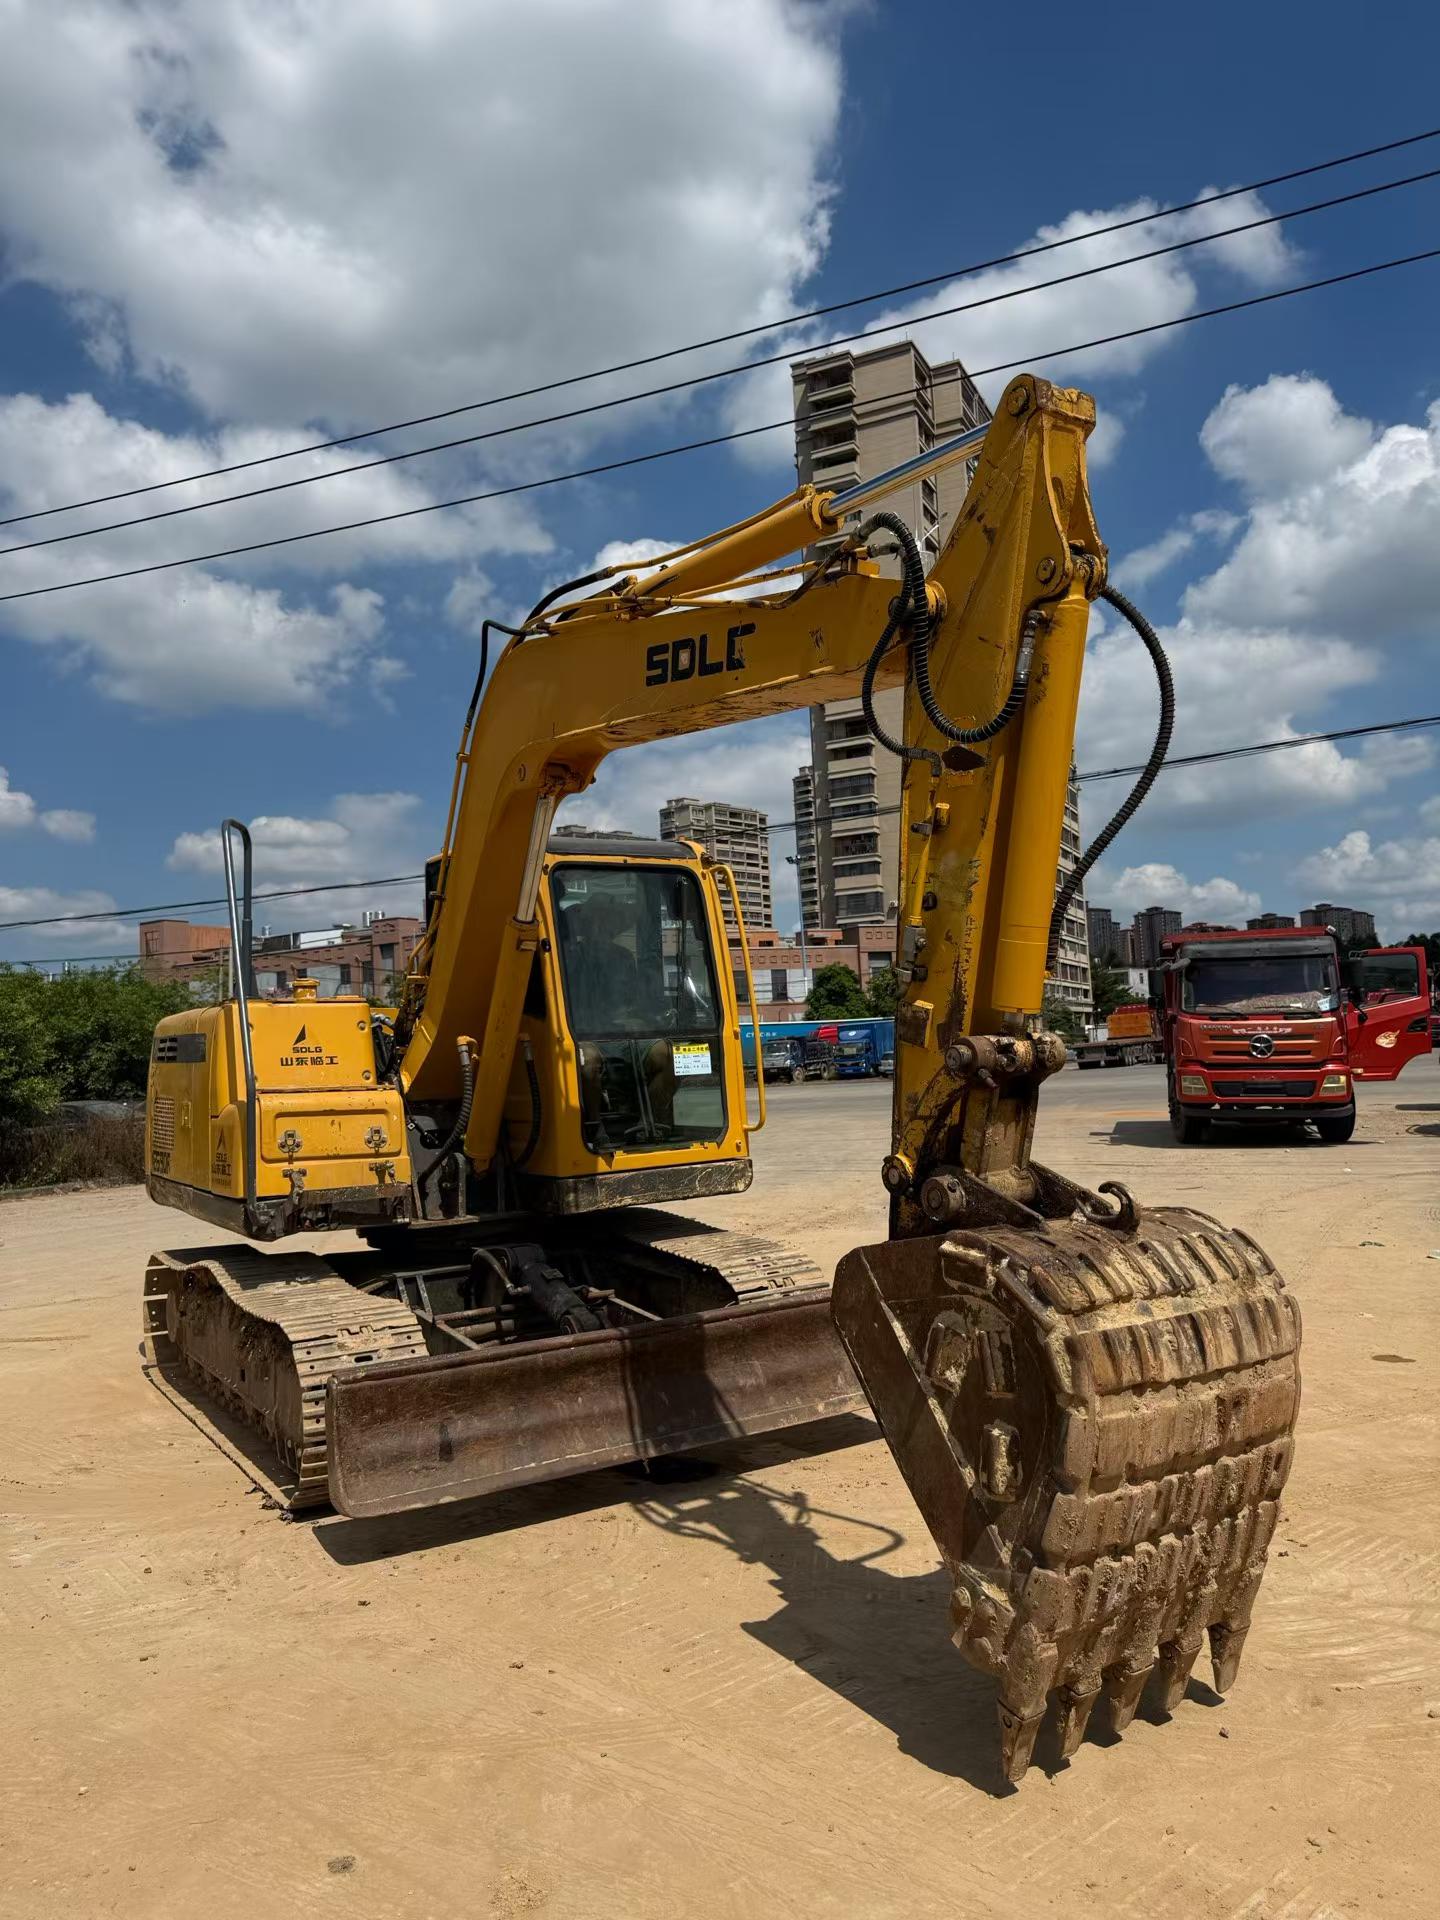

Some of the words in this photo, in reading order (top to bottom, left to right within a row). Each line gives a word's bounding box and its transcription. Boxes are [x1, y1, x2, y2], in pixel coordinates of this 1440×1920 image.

[292, 1046, 322, 1054] SDLG
[280, 1056, 338, 1066] 山东临工
